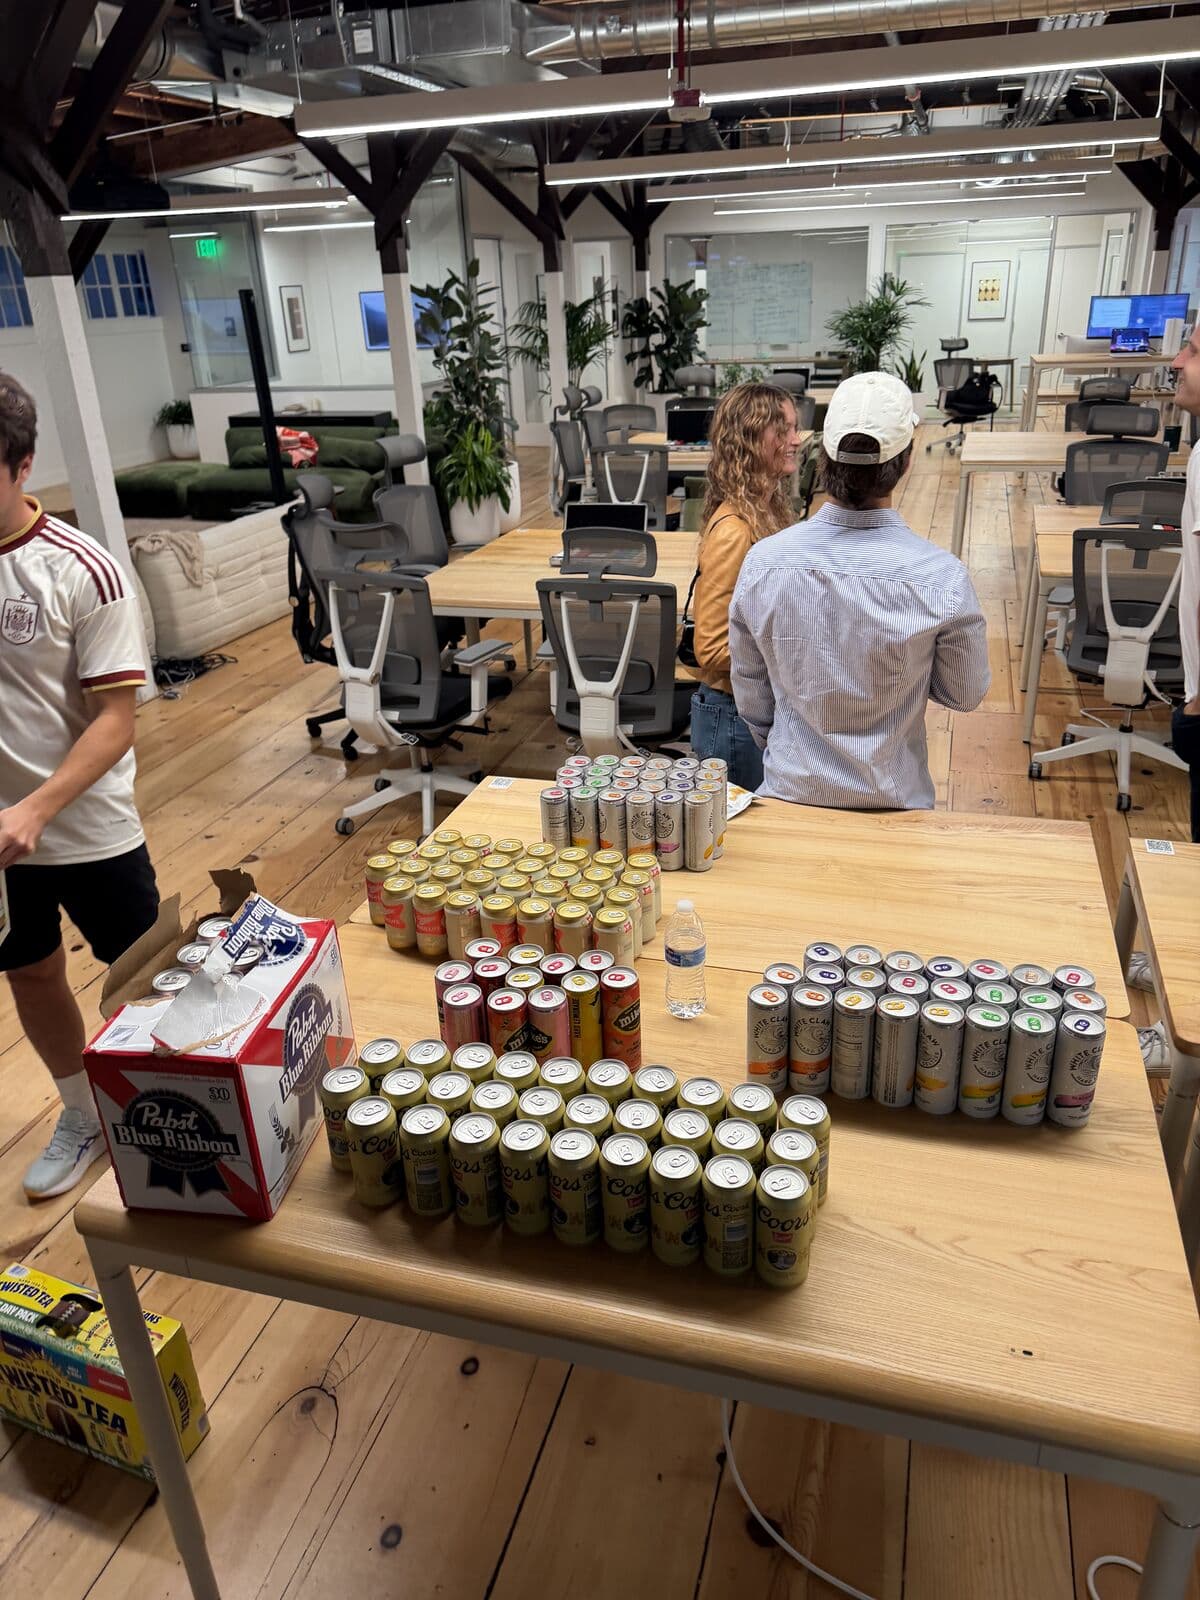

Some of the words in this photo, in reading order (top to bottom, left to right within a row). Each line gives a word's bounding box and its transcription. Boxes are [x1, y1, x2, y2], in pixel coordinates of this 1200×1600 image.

[288, 998, 319, 1056] Pabst
[281, 1055, 304, 1100] Blue
[302, 1012, 333, 1066] Ribbon
[208, 1086, 231, 1101] 30
[136, 1101, 198, 1131] Pabst
[116, 1125, 162, 1147] Blue
[161, 1128, 236, 1154] Ribbon
[757, 1205, 810, 1232] Coors
[0, 1281, 40, 1298] WISTED
[35, 1292, 55, 1308] TEA
[1, 1303, 17, 1317] DAY
[17, 1307, 39, 1323] PACK
[81, 1396, 128, 1437] TEA
